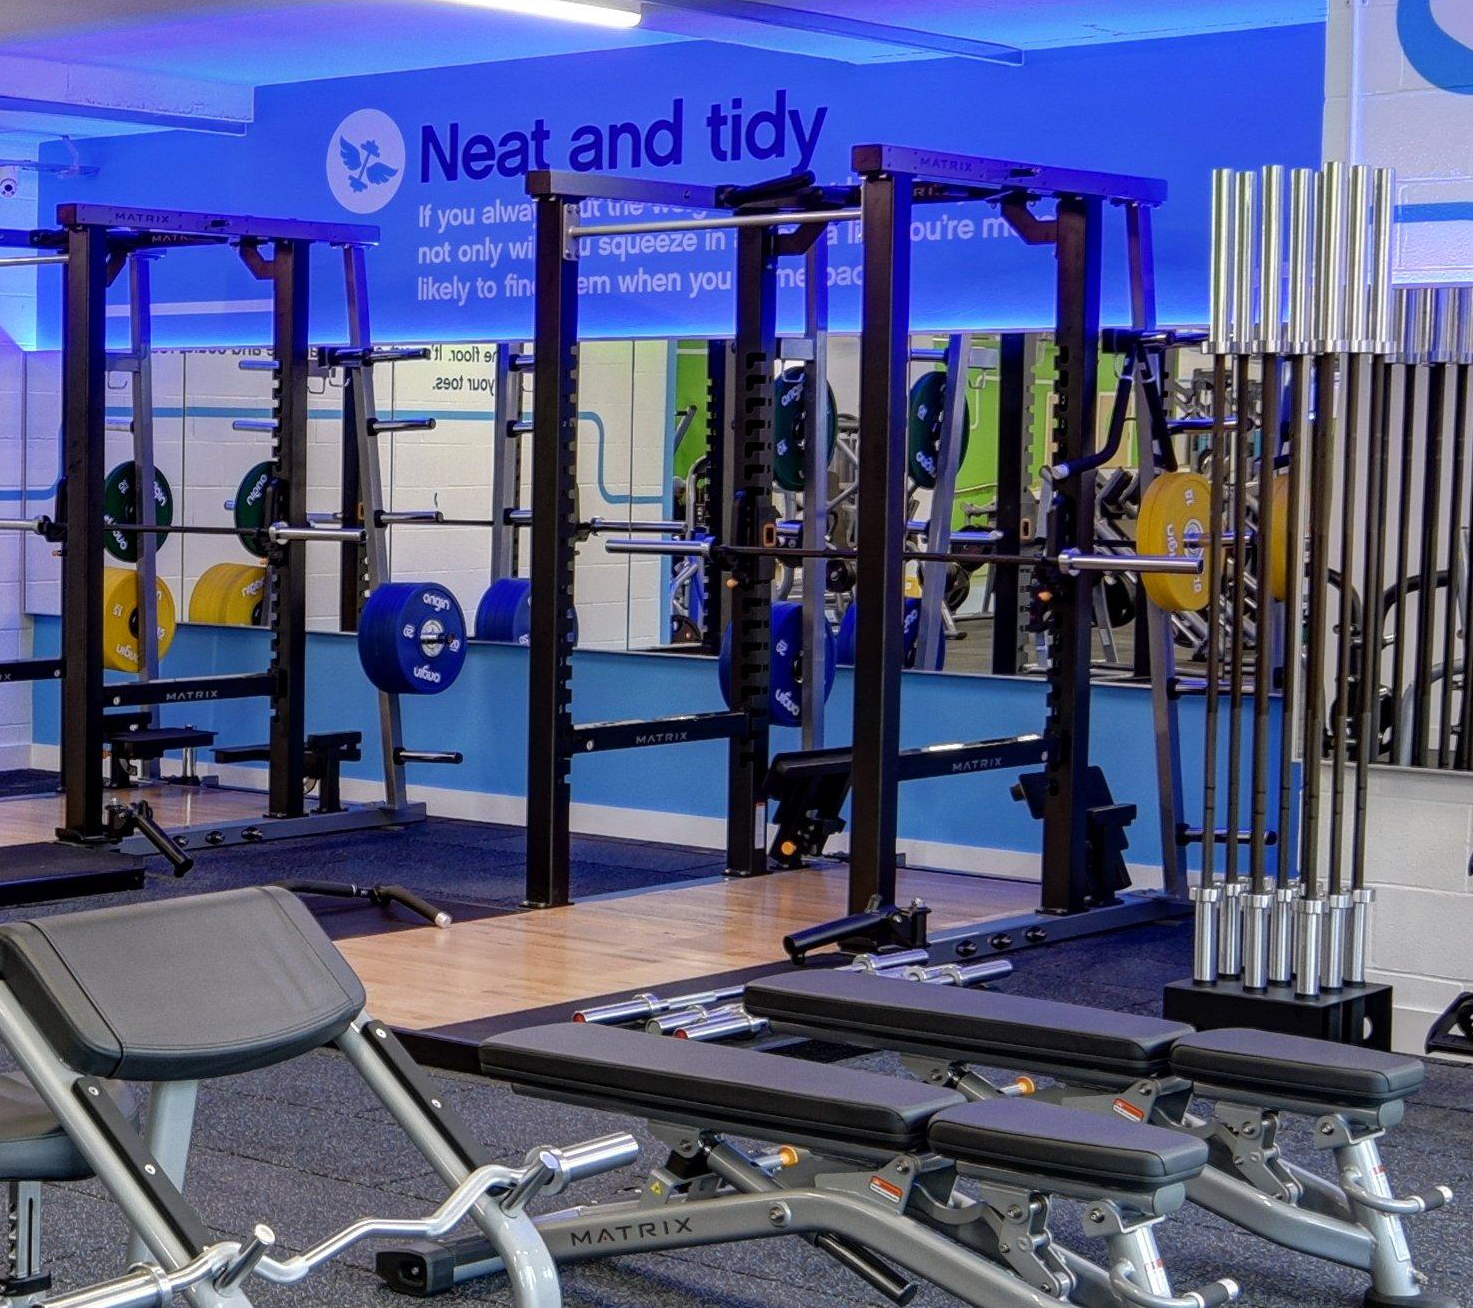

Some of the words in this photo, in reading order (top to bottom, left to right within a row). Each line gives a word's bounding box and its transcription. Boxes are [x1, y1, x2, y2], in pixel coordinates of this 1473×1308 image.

[420, 119, 551, 183] Neat
[568, 98, 684, 172] and
[706, 89, 828, 175] tidy
[114, 212, 170, 223] MATRIX
[418, 205, 432, 227] If
[437, 207, 475, 234] you
[481, 199, 536, 225] alwa
[418, 241, 451, 264] not
[458, 239, 503, 268] only
[598, 232, 697, 260] squeeze
[705, 229, 725, 252] in
[417, 276, 470, 306] likely
[476, 276, 497, 298] to
[617, 268, 681, 293] when
[688, 270, 732, 298] you
[166, 690, 218, 701] MATRIX
[636, 732, 687, 744] MATRIX
[952, 757, 1003, 771] MATRIX
[570, 1217, 693, 1247] MATRIX
